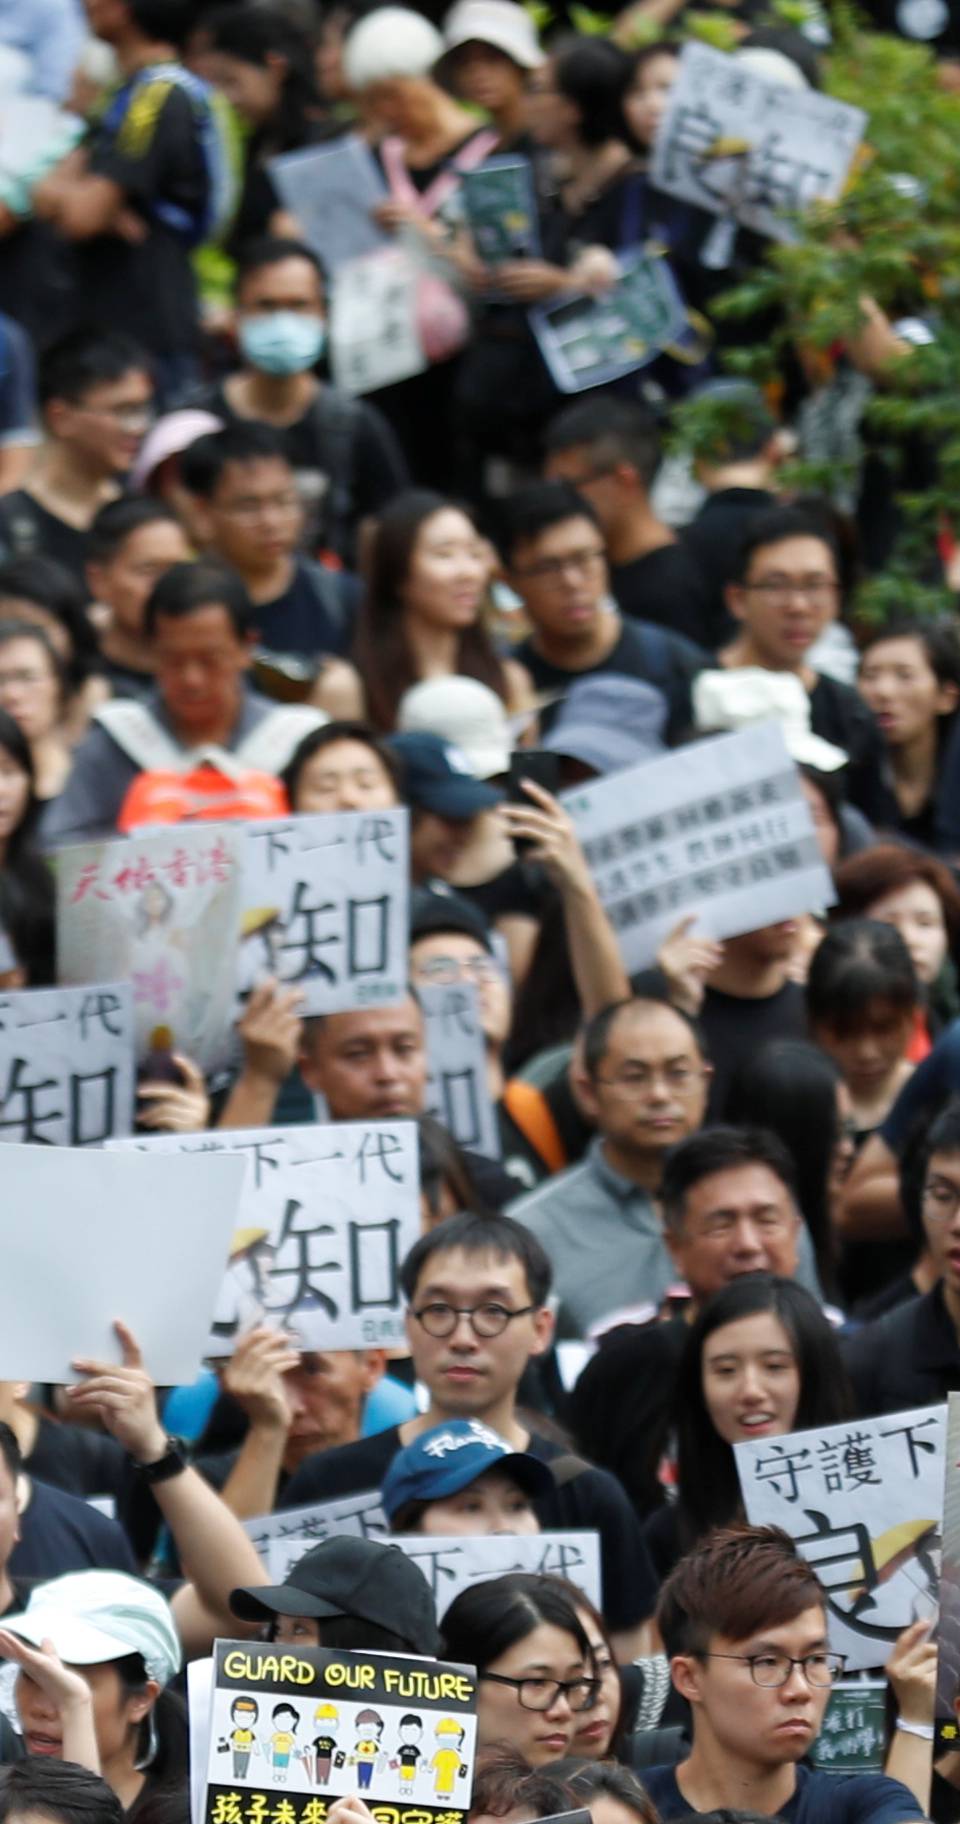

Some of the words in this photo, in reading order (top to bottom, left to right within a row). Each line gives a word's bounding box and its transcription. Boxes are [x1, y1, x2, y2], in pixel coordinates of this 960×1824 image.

[249, 818, 397, 872] 下一代
[276, 881, 390, 987] 知
[240, 1198, 401, 1328] 知
[754, 1417, 939, 1504] 守護下
[223, 1651, 316, 1685] GUARD
[324, 1663, 376, 1690] OUR
[383, 1669, 475, 1702] FUTURE
